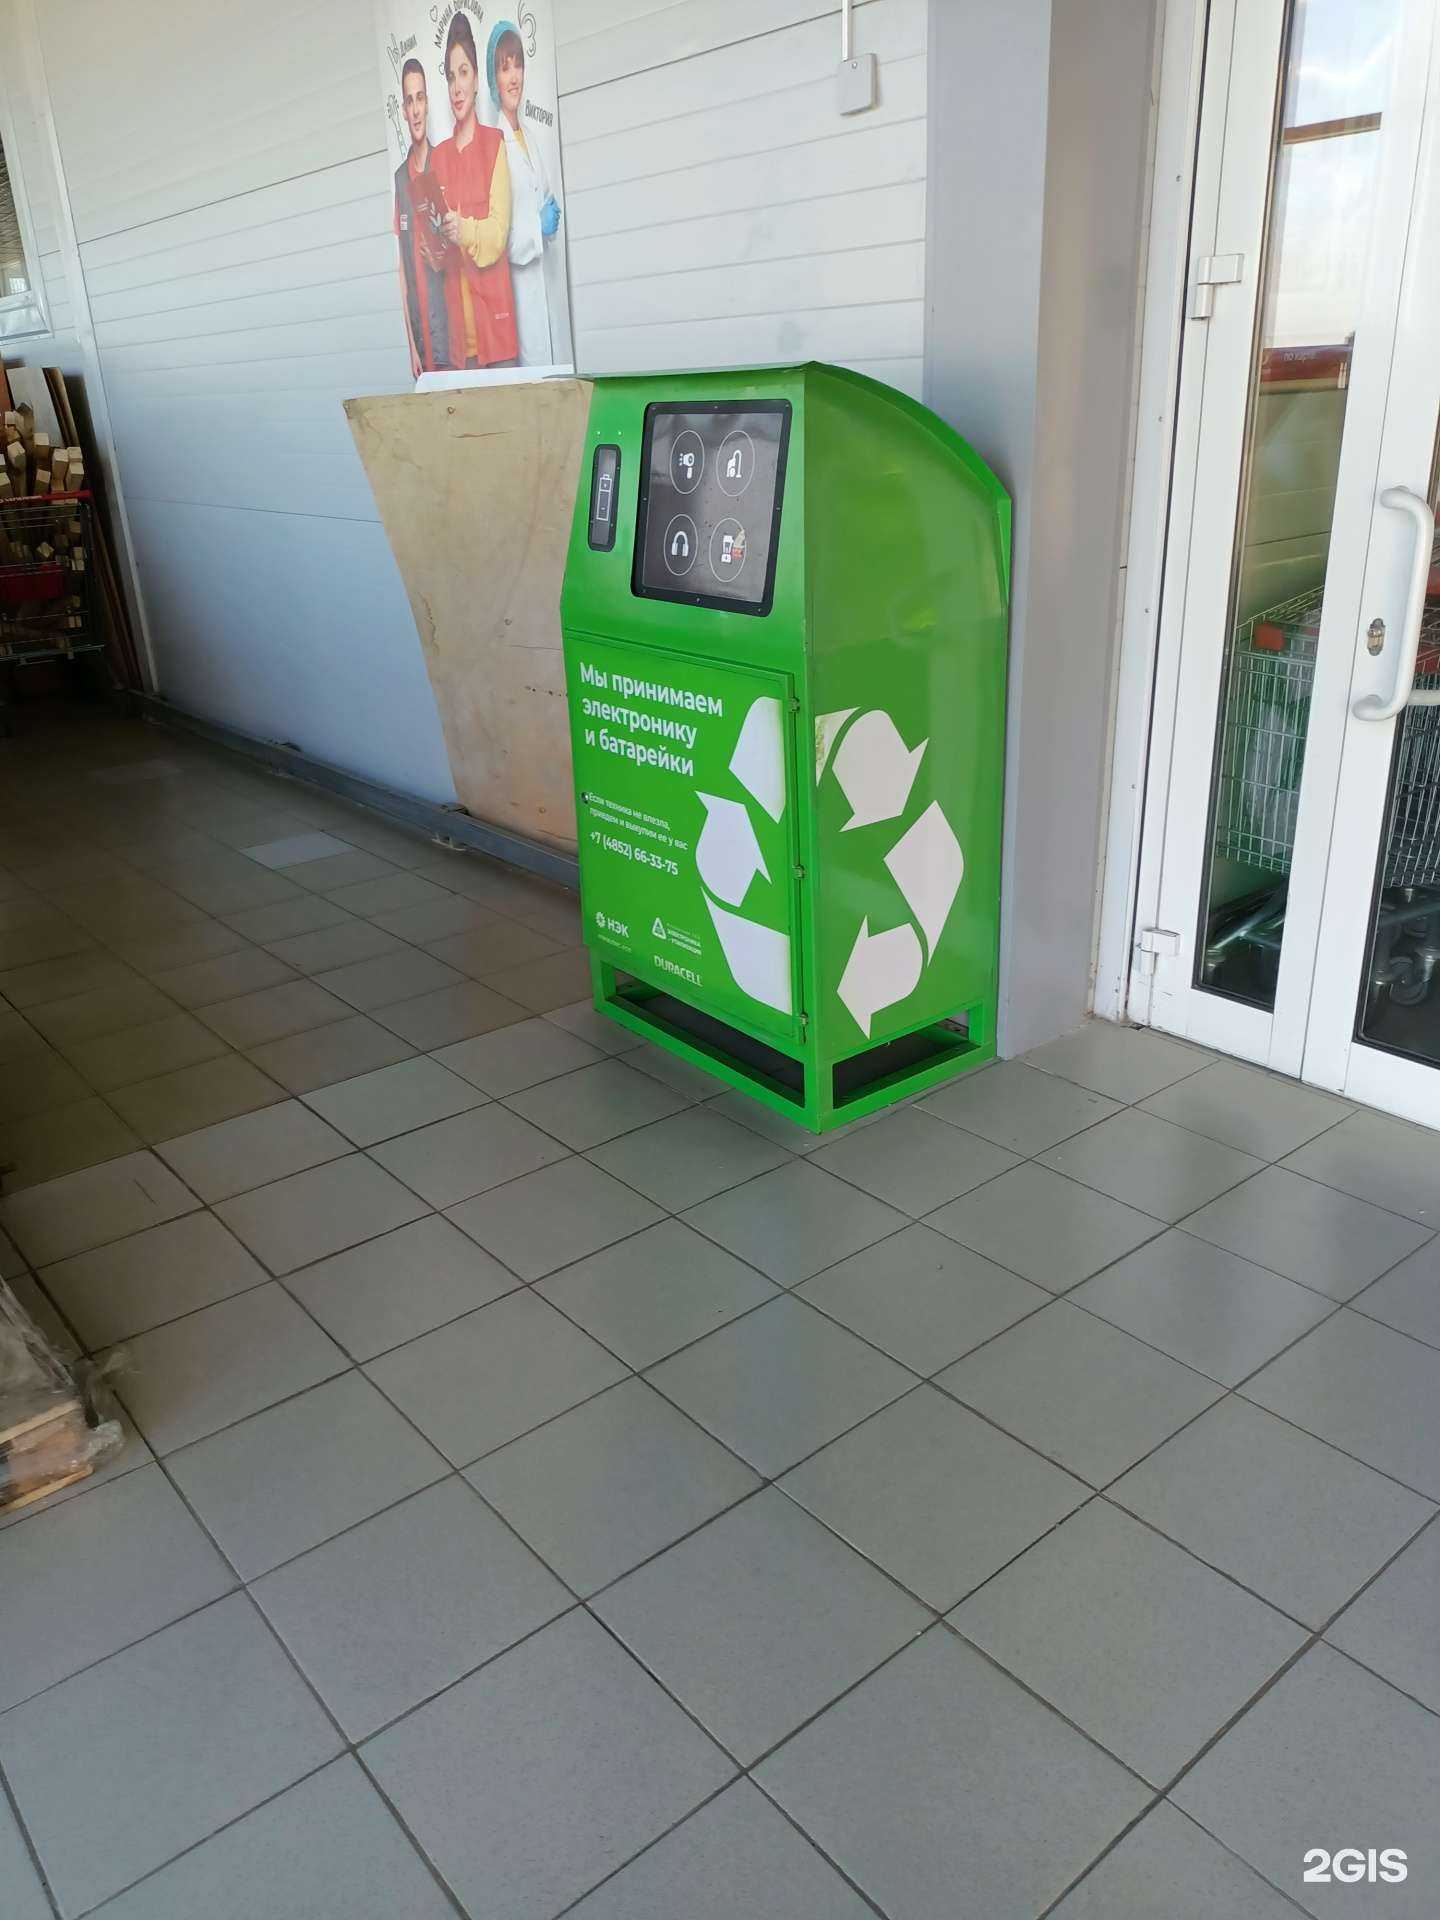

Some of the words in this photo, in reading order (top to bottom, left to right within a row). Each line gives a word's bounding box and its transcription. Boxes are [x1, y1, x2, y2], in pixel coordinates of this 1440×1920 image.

[525, 99, 553, 127] ВИКТОРИЯ
[580, 662, 608, 688] Мы
[612, 674, 723, 717] принимаем
[582, 698, 698, 749] электронику
[585, 729, 596, 746] и
[599, 729, 694, 777] батарейки
[590, 832, 601, 844] +7
[603, 834, 632, 860] (4852)
[634, 847, 679, 875] 66-33-75
[654, 955, 703, 987] DURACELL
